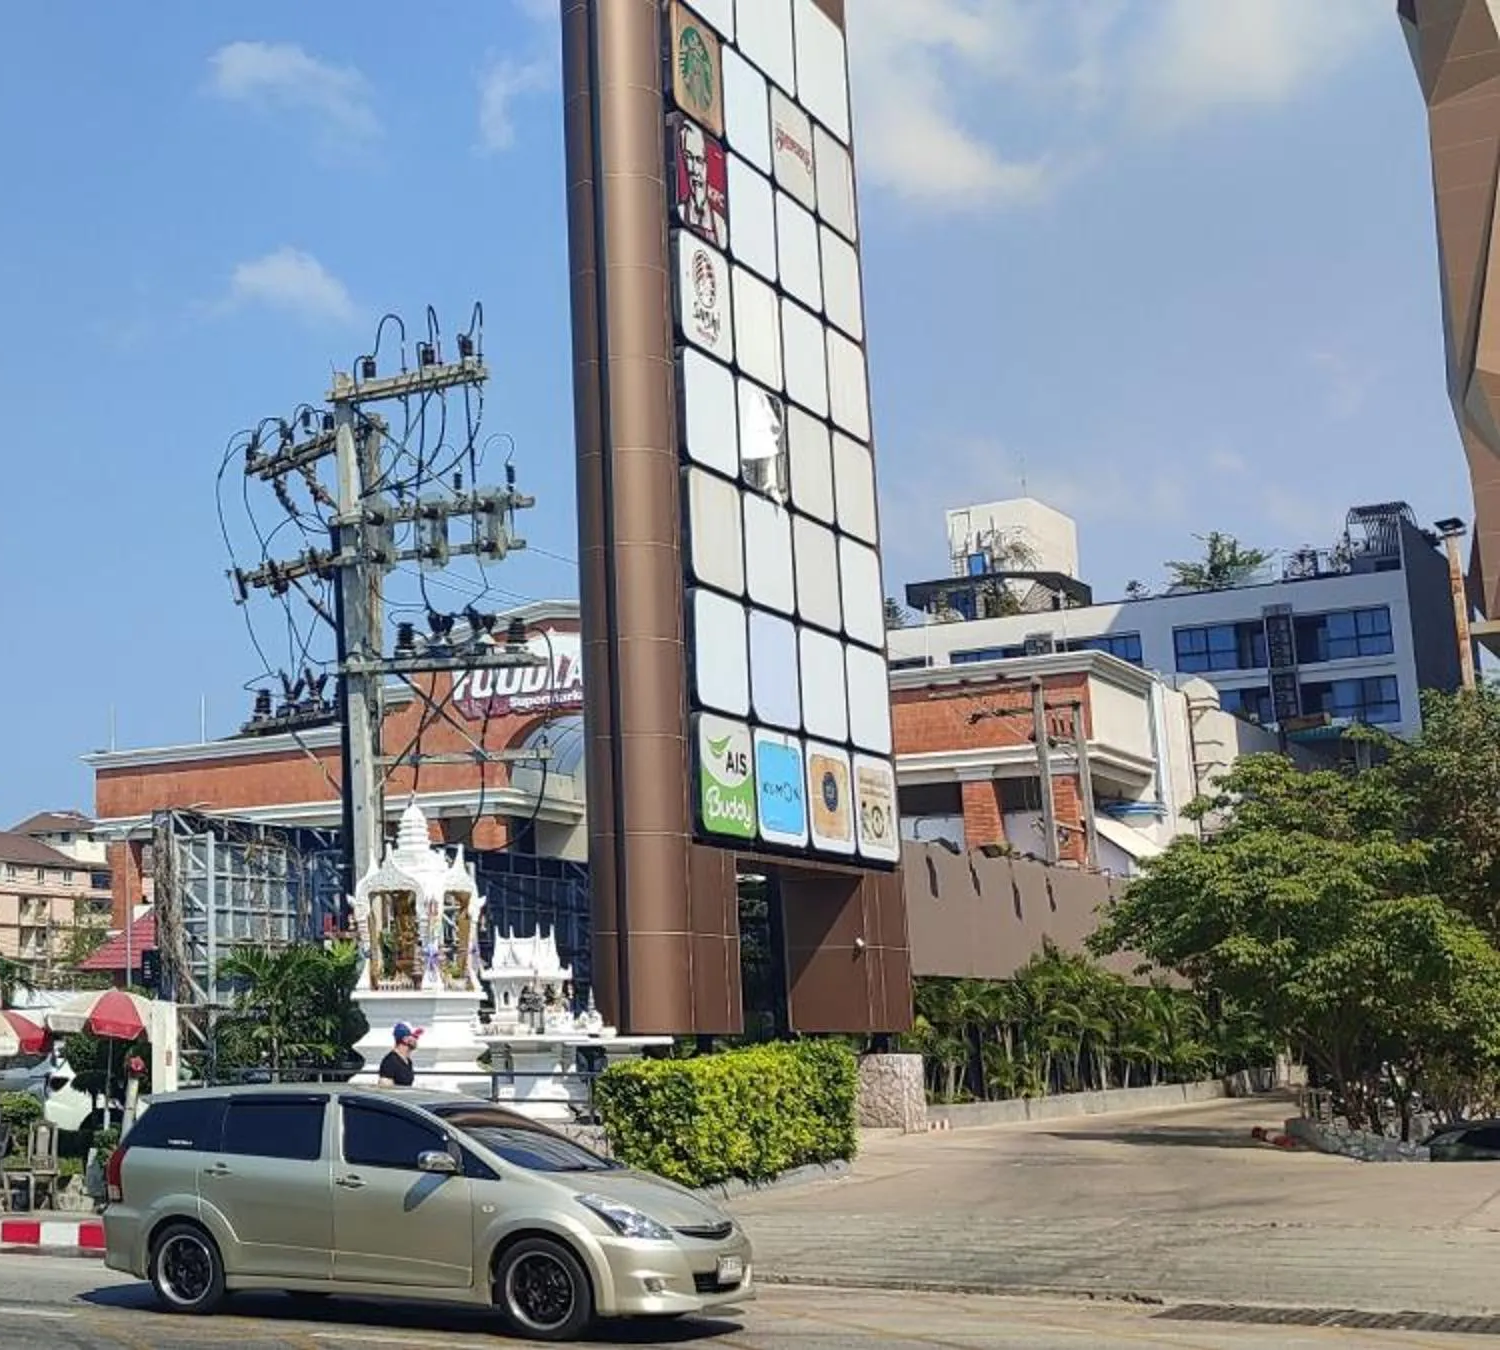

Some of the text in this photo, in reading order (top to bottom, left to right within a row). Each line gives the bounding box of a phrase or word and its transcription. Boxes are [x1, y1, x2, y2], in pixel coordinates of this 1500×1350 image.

[453, 655, 583, 702] FOODLA
[725, 751, 748, 776] AIS
[705, 786, 753, 829] Buddy
